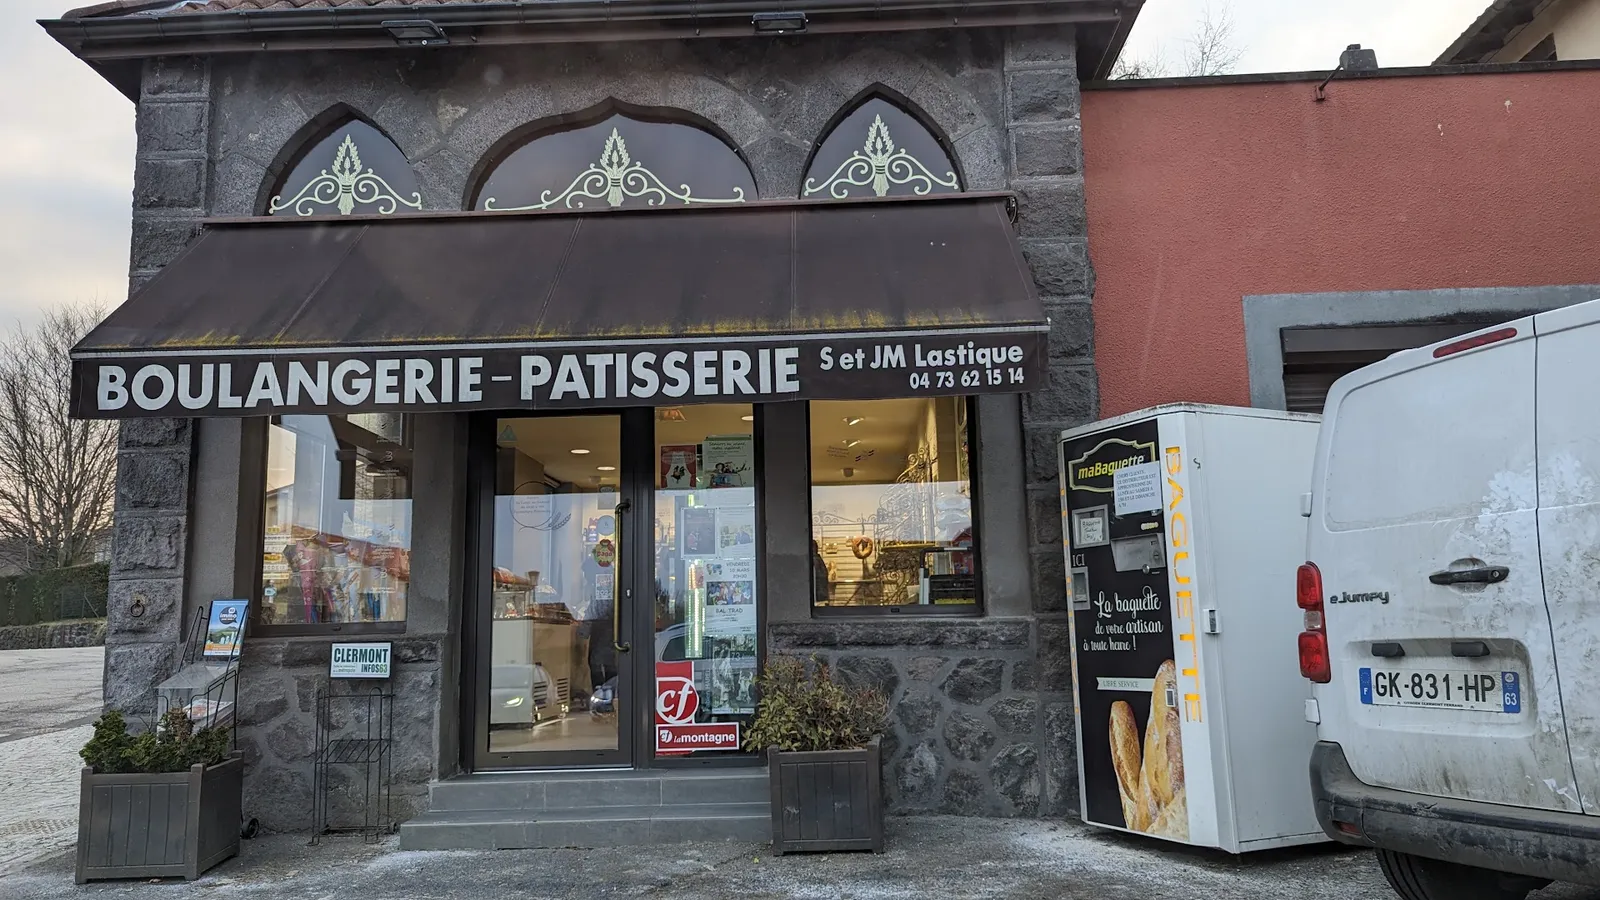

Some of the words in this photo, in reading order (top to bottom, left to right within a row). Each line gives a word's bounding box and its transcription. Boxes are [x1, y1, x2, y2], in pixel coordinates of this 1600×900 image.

[820, 346, 833, 371] S
[839, 348, 865, 370] et
[870, 345, 907, 369] JM
[914, 341, 1024, 368] Lastique
[98, 357, 483, 411] BOULANGERIE
[520, 347, 799, 401] PATISSERIE
[909, 372, 930, 389] 04
[936, 371, 955, 388] 73
[961, 370, 980, 387] 62
[986, 369, 1001, 385] 15
[1008, 367, 1024, 384] 14
[1078, 455, 1144, 480] maBaguette
[1072, 553, 1085, 567] ICI
[1164, 446, 1203, 723] BAGUETTE
[1094, 590, 1113, 619] La
[1114, 585, 1162, 620] baguette
[1095, 620, 1105, 635] de
[1106, 623, 1125, 635] votre
[1126, 619, 1164, 634] artisan
[1083, 638, 1089, 651] à
[1090, 640, 1108, 651] toute
[1109, 636, 1131, 651] heure
[334, 648, 389, 663] CLERMONT
[361, 663, 388, 673] INFOS63
[1118, 681, 1139, 689] SERVICE
[1363, 687, 1368, 695] F
[1375, 671, 1496, 703] GK-831-HP
[1504, 692, 1517, 706] 63
